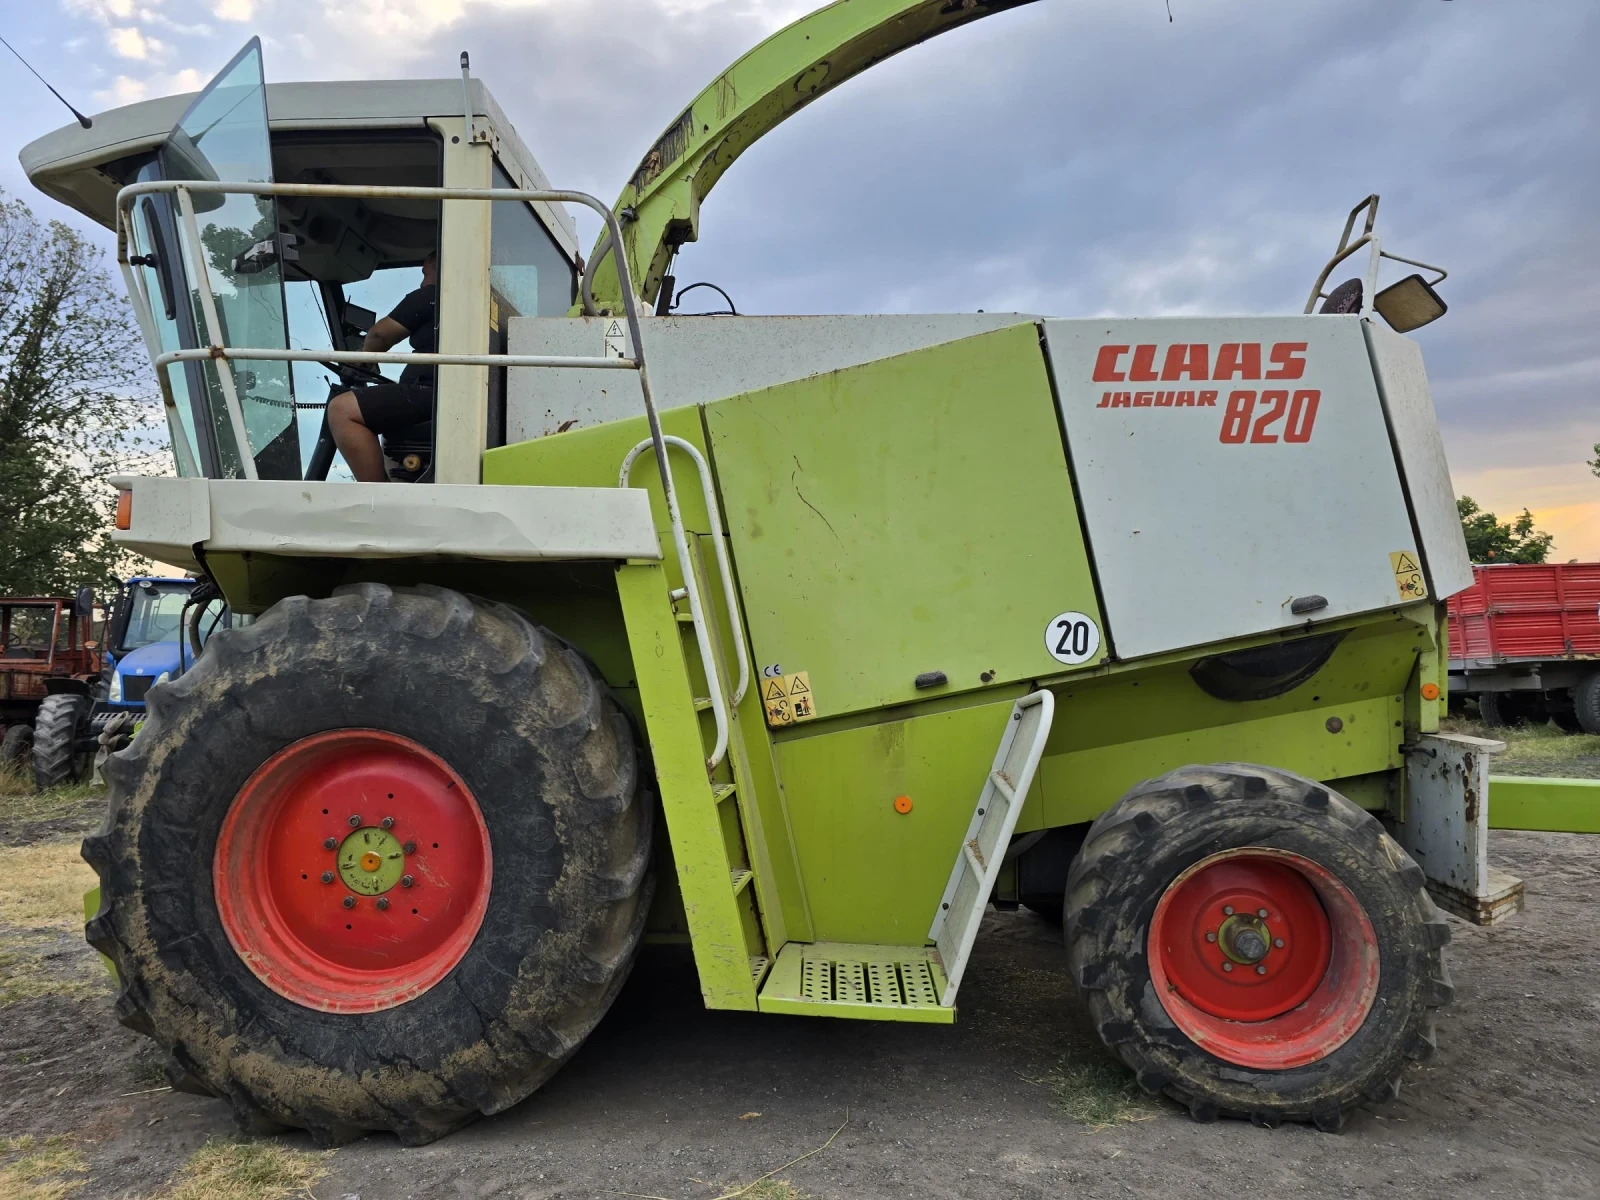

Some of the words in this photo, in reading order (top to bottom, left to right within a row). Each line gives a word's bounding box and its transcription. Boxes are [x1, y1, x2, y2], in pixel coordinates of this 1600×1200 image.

[1092, 342, 1308, 382] CLAAS
[1096, 390, 1218, 408] JAGUAR
[1219, 389, 1321, 443] 820
[1056, 620, 1089, 656] 20
[764, 664, 781, 677] CE
